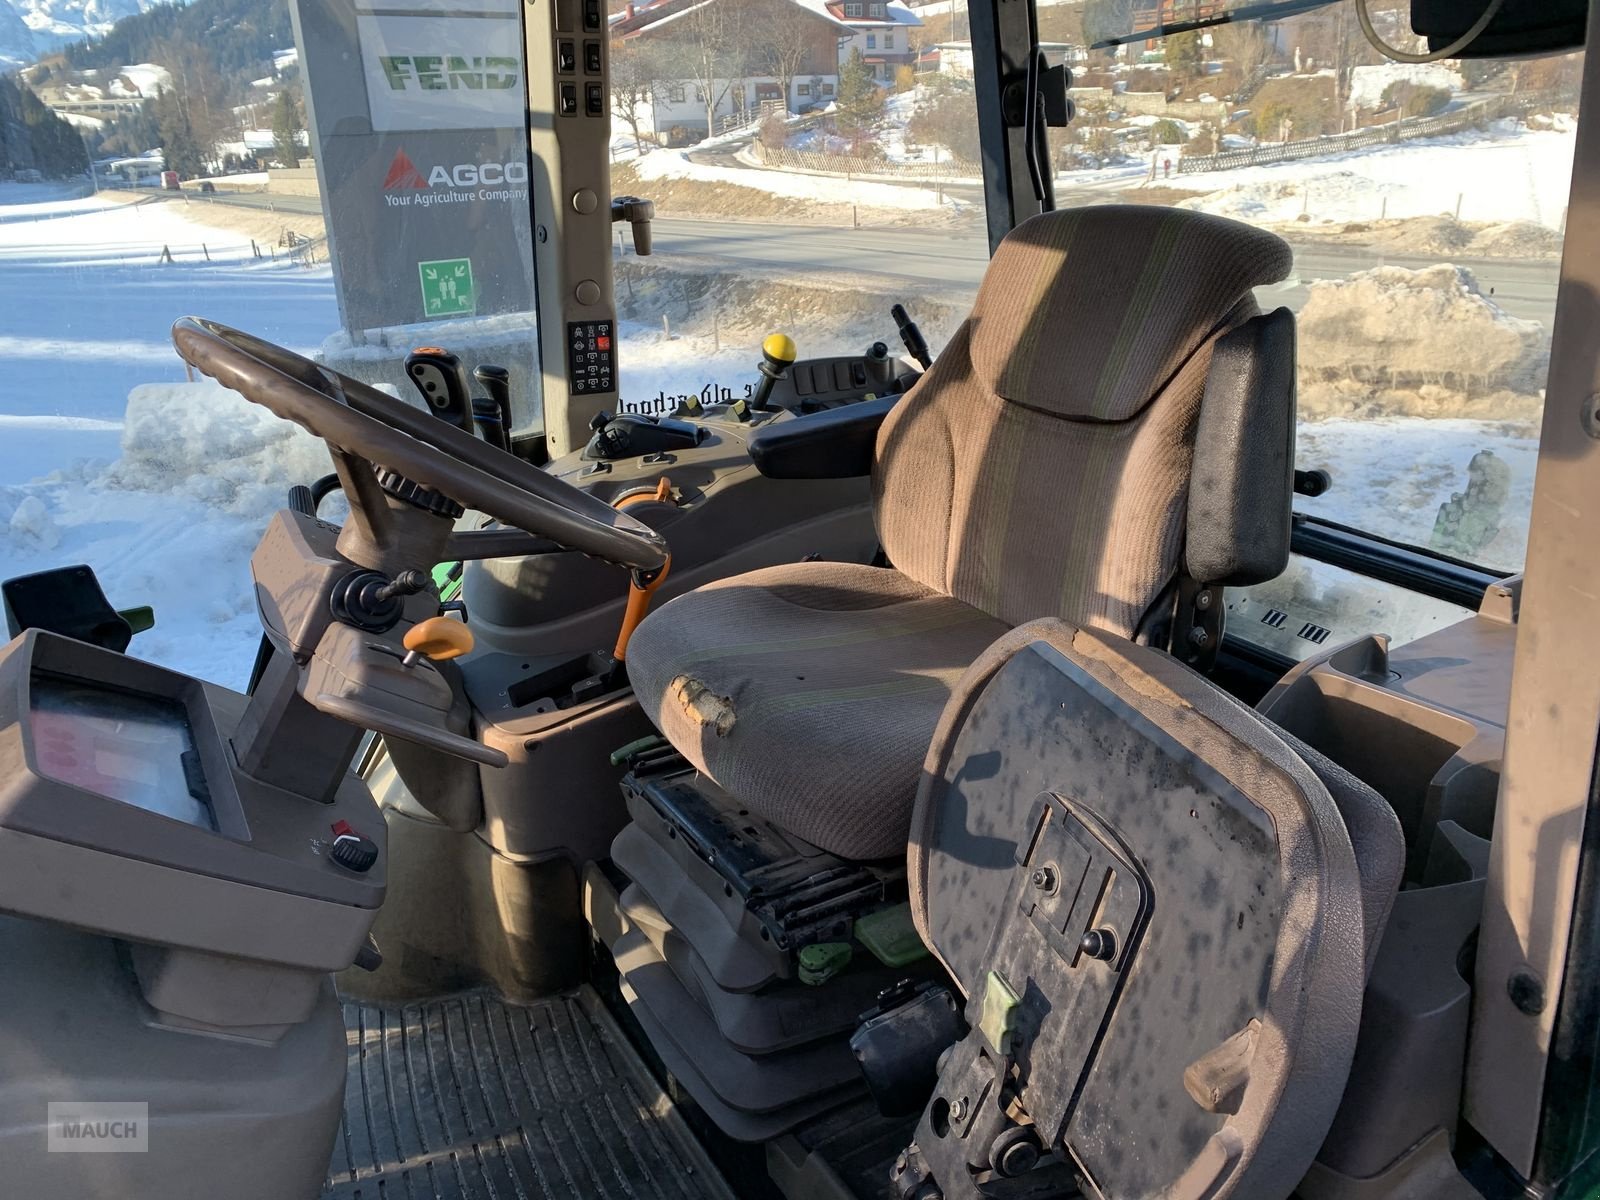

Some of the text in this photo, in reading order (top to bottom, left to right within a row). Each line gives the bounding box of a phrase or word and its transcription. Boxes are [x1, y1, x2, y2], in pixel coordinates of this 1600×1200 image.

[428, 161, 528, 187] AGCO
[385, 188, 528, 207] Your Agriculture Company
